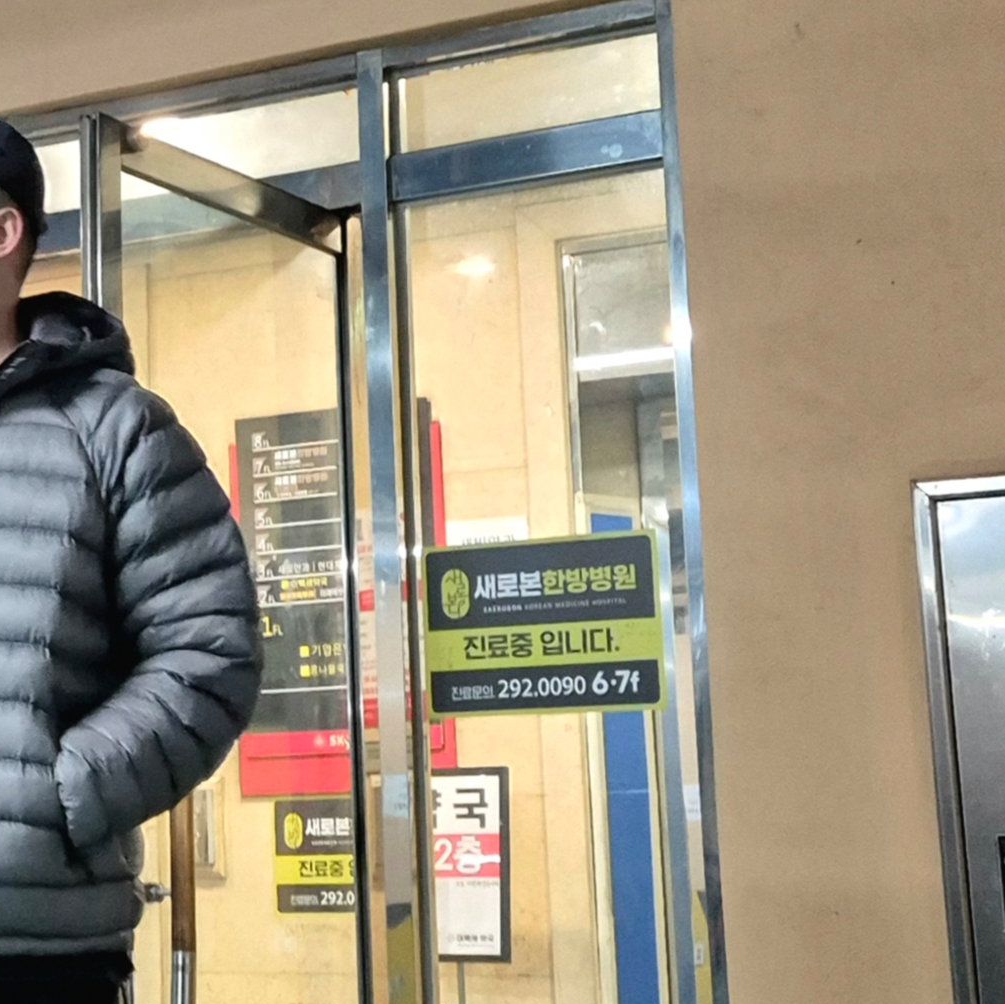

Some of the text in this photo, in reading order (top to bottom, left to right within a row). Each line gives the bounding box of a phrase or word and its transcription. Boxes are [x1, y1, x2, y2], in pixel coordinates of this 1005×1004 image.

[474, 564, 637, 600] 새로본한방병원
[311, 643, 346, 657] 기업은
[463, 628, 620, 660] 진료중 입니다.
[451, 685, 495, 701] 진료문의
[497, 675, 586, 699] 292.0090
[305, 816, 353, 837] 새로본
[433, 834, 482, 875] 2층
[298, 860, 344, 878] 진료중
